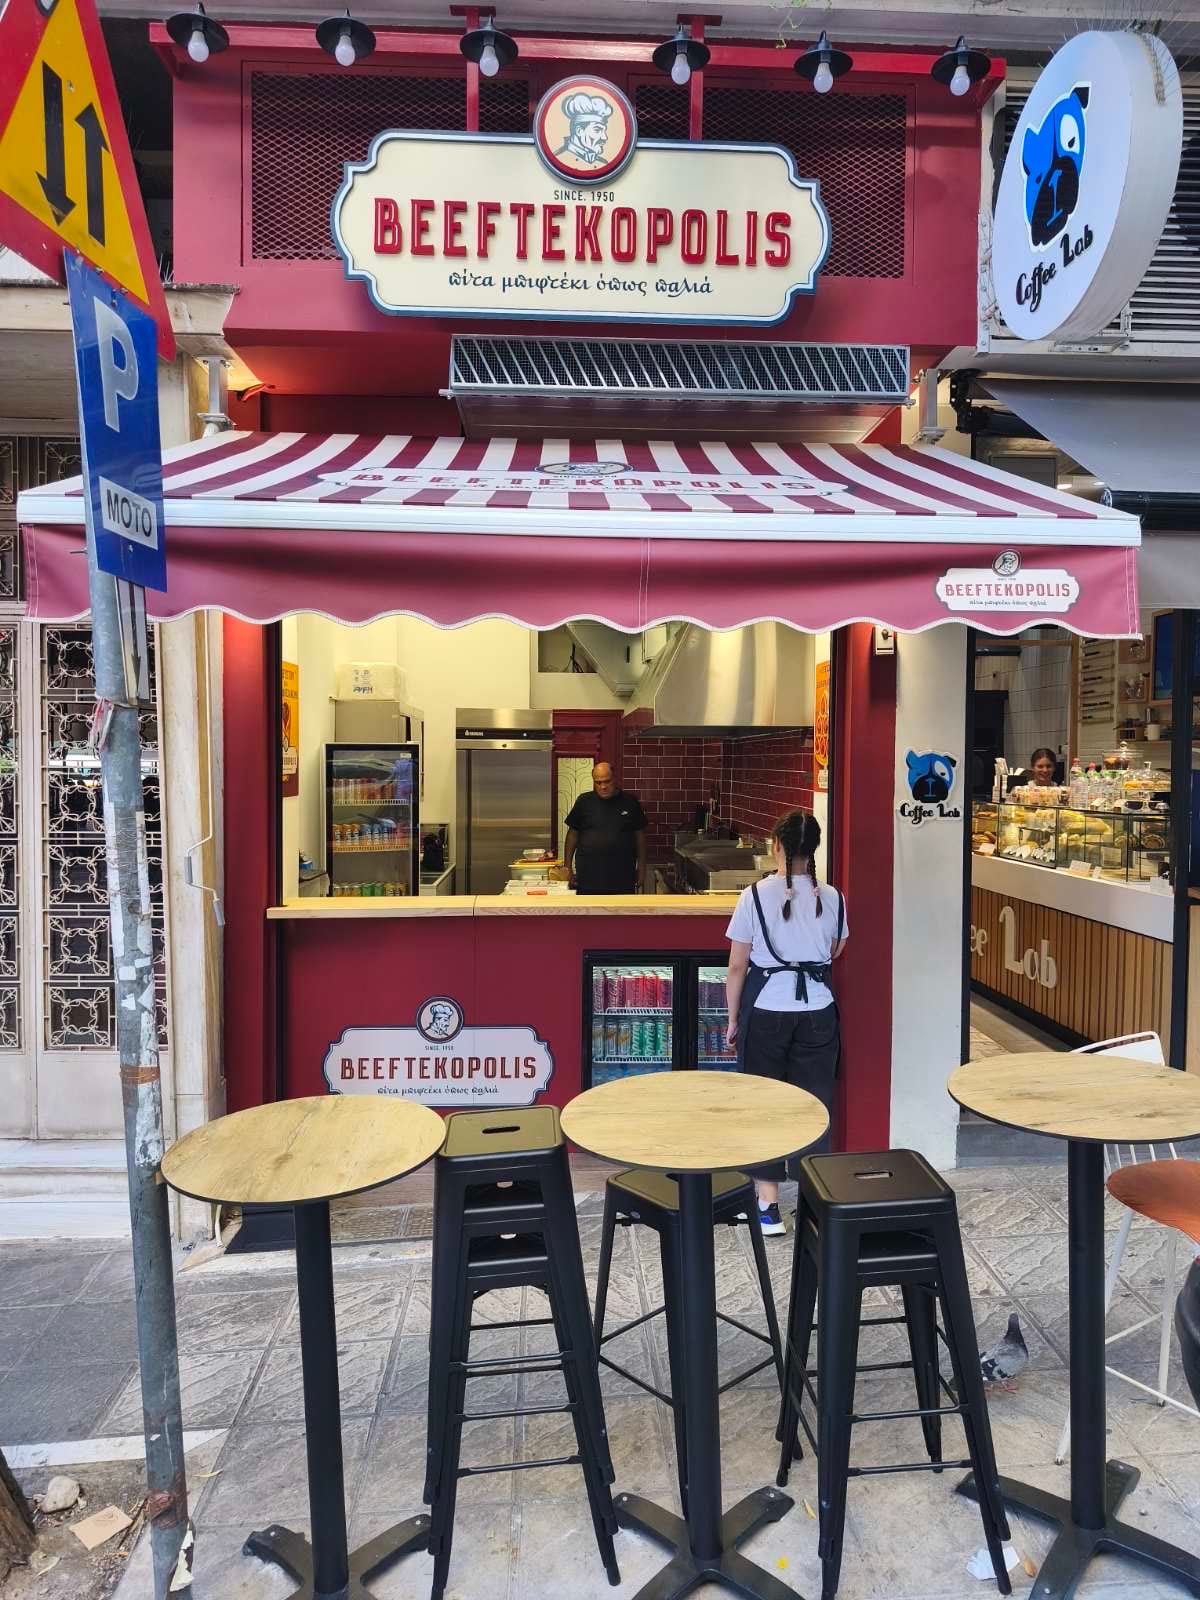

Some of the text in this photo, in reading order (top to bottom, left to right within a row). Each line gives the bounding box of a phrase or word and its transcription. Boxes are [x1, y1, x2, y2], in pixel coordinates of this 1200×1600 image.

[591, 191, 615, 202] 1950
[373, 196, 792, 268] BEEFTEKOPOLIS
[448, 268, 496, 287] πίτα
[596, 273, 647, 297] όπως
[655, 276, 714, 298] παλιά
[1015, 224, 1093, 313] Coffee Lab
[94, 296, 139, 433] P
[352, 473, 817, 490] BEEFTEKOPOLIS
[106, 488, 152, 538] MOTO
[945, 583, 1070, 597] BEEFTEKOPOLIS
[900, 803, 960, 825] Coffee Lab
[999, 905, 1057, 989] Lab
[340, 1056, 537, 1080] BEEFTEKOPOLIS
